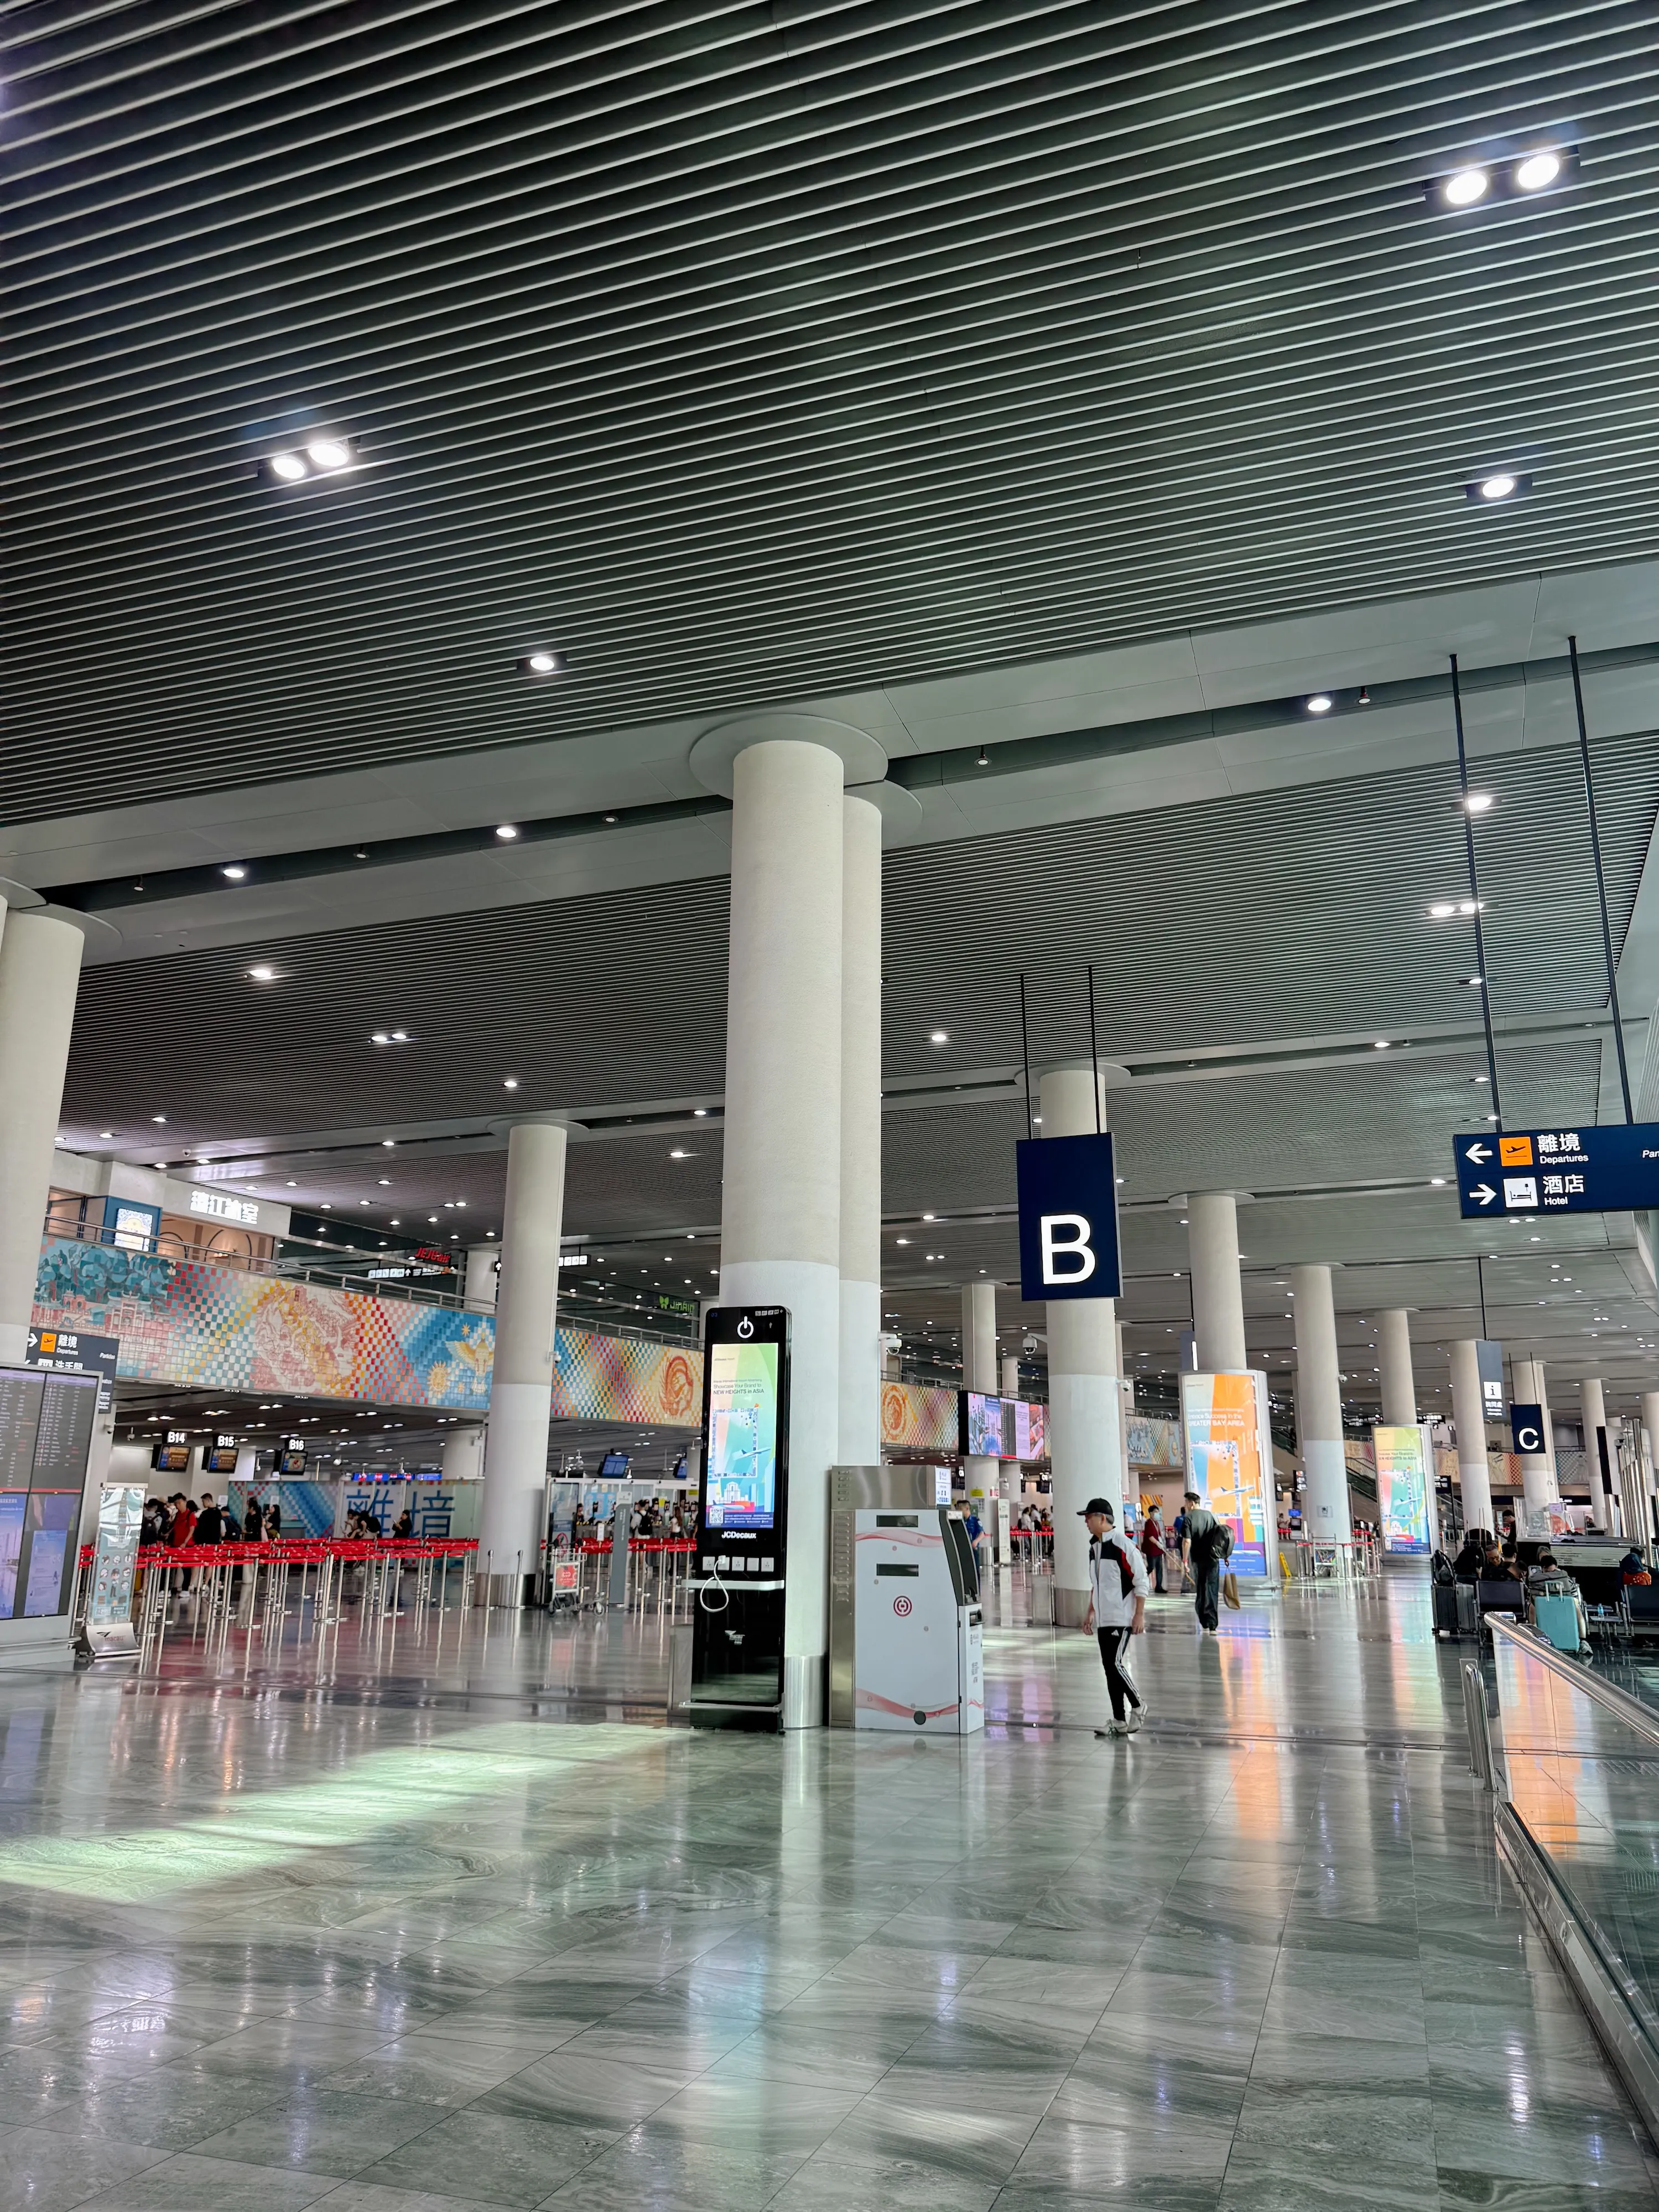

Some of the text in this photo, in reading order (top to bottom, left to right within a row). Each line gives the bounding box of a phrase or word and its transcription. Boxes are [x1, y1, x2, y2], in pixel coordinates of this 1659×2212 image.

[1537, 1133, 1581, 1154] 離境
[1540, 1154, 1589, 1165] Departures
[1542, 1174, 1584, 1195] 酒店
[1544, 1196, 1568, 1205] Hotel
[1041, 1214, 1096, 1285] B
[58, 1334, 78, 1348] 離境
[56, 1347, 79, 1356] Departures
[168, 1431, 185, 1444] B14
[217, 1435, 235, 1447] B15
[1518, 1427, 1539, 1450] C
[289, 1439, 304, 1451] B16
[721, 1531, 757, 1539] JCDecaux
